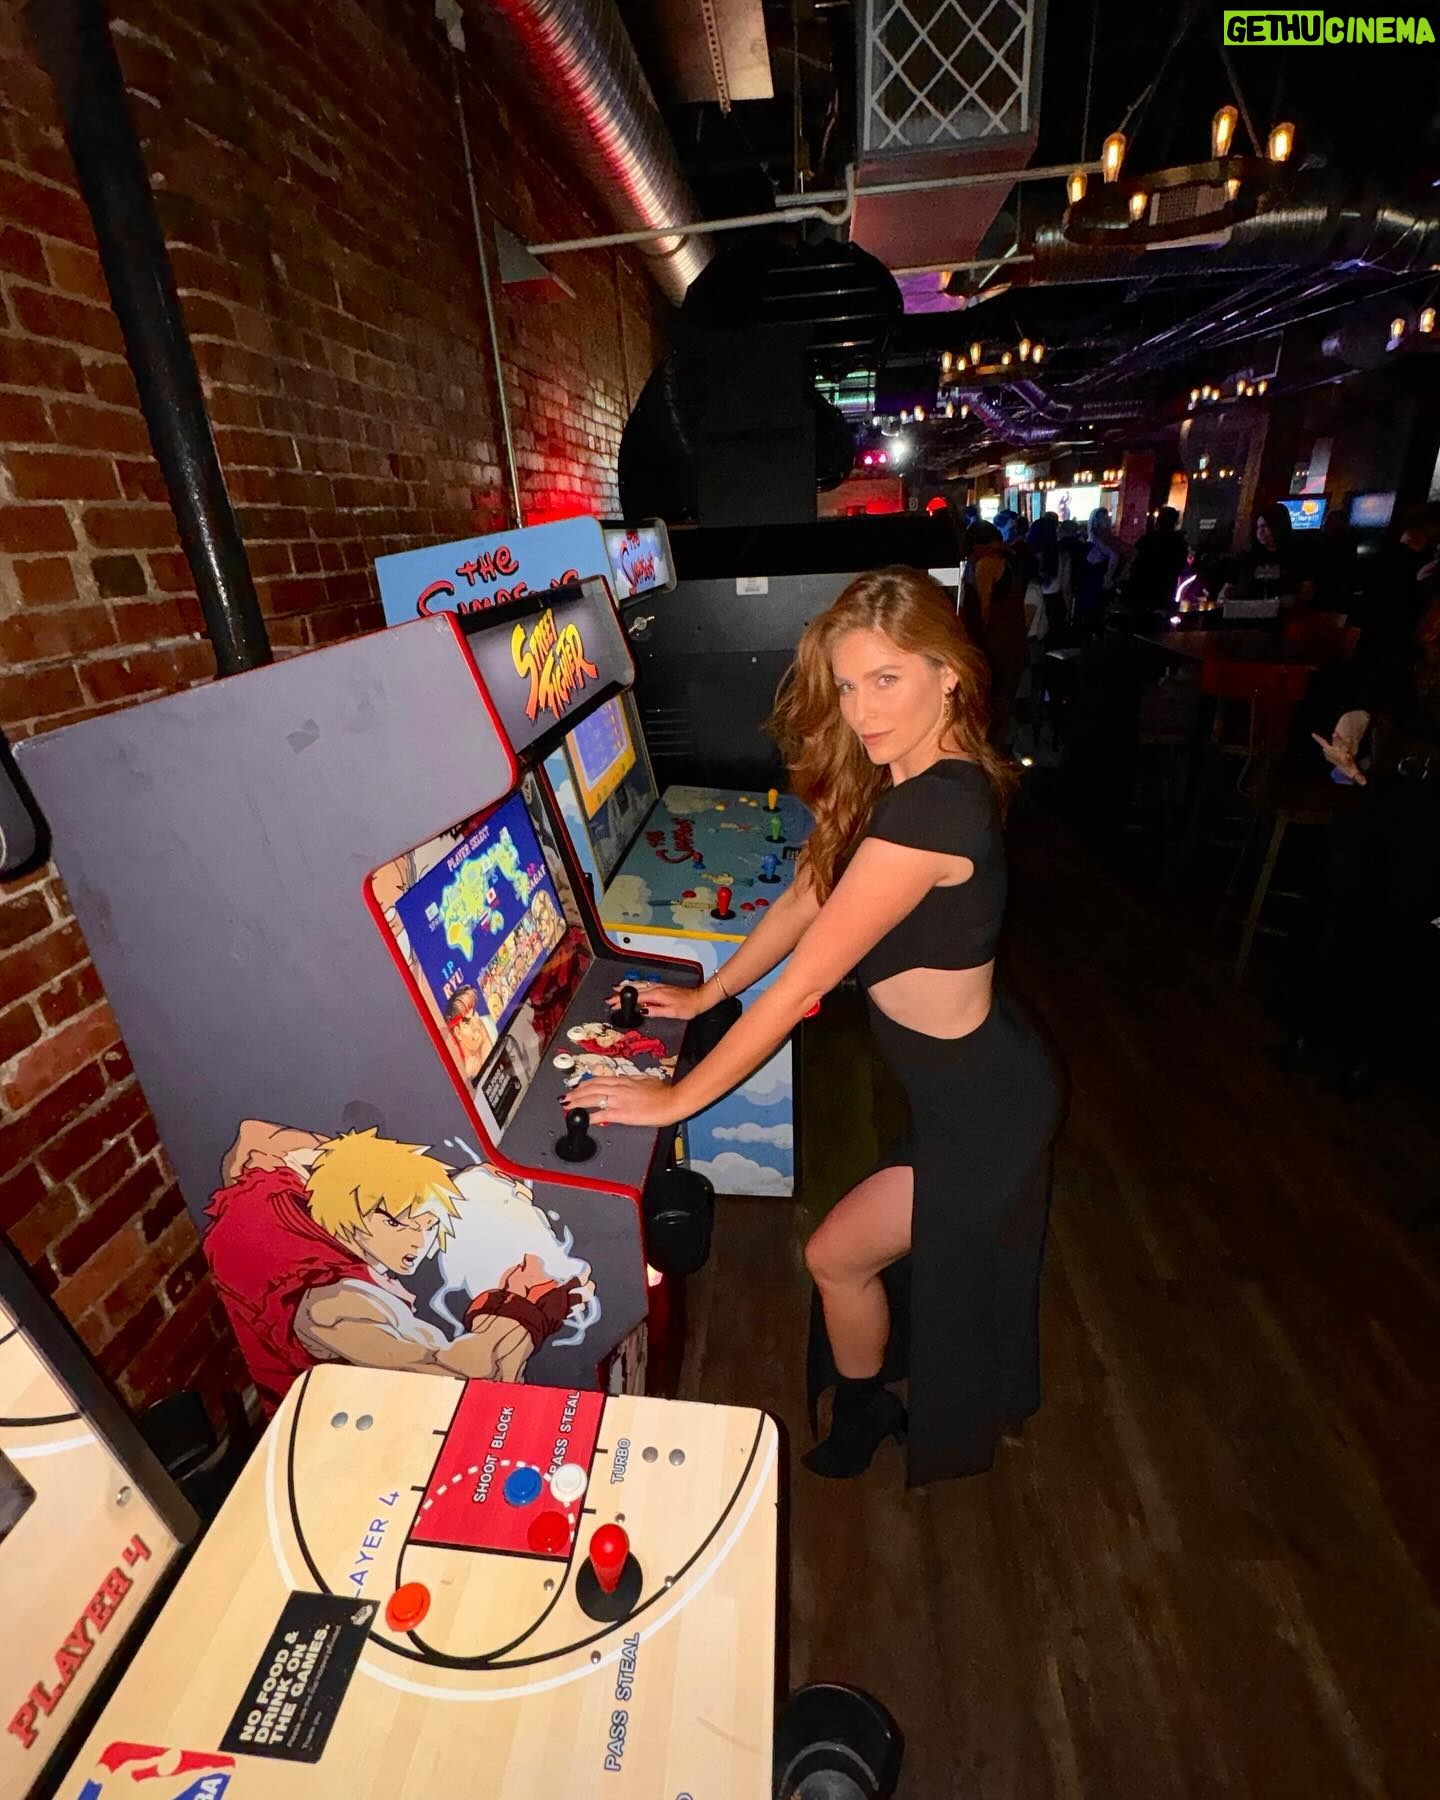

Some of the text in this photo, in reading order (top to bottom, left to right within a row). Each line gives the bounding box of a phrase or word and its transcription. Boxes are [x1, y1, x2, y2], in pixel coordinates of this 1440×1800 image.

[456, 545, 520, 586] THE
[512, 608, 557, 727] STREET
[538, 622, 599, 721] FIGHTER
[446, 825, 491, 873] PLAYER SELECT
[441, 960, 455, 980] 1P
[442, 967, 464, 1000] RYU
[473, 1405, 516, 1504] SHOOT BLOCK
[548, 1390, 582, 1477] PASS STEAL
[610, 1438, 632, 1485] TURBO
[349, 1489, 402, 1598] AYER 4
[7, 1533, 153, 1751] PLAYER 4
[239, 1630, 300, 1742] NO FOOD &
[267, 1702, 298, 1745] THE
[290, 1623, 331, 1698] GAMES.
[253, 1643, 308, 1744] DRINK ON
[604, 1632, 641, 1772] PASS STEAL
[193, 1778, 224, 1800] BA
